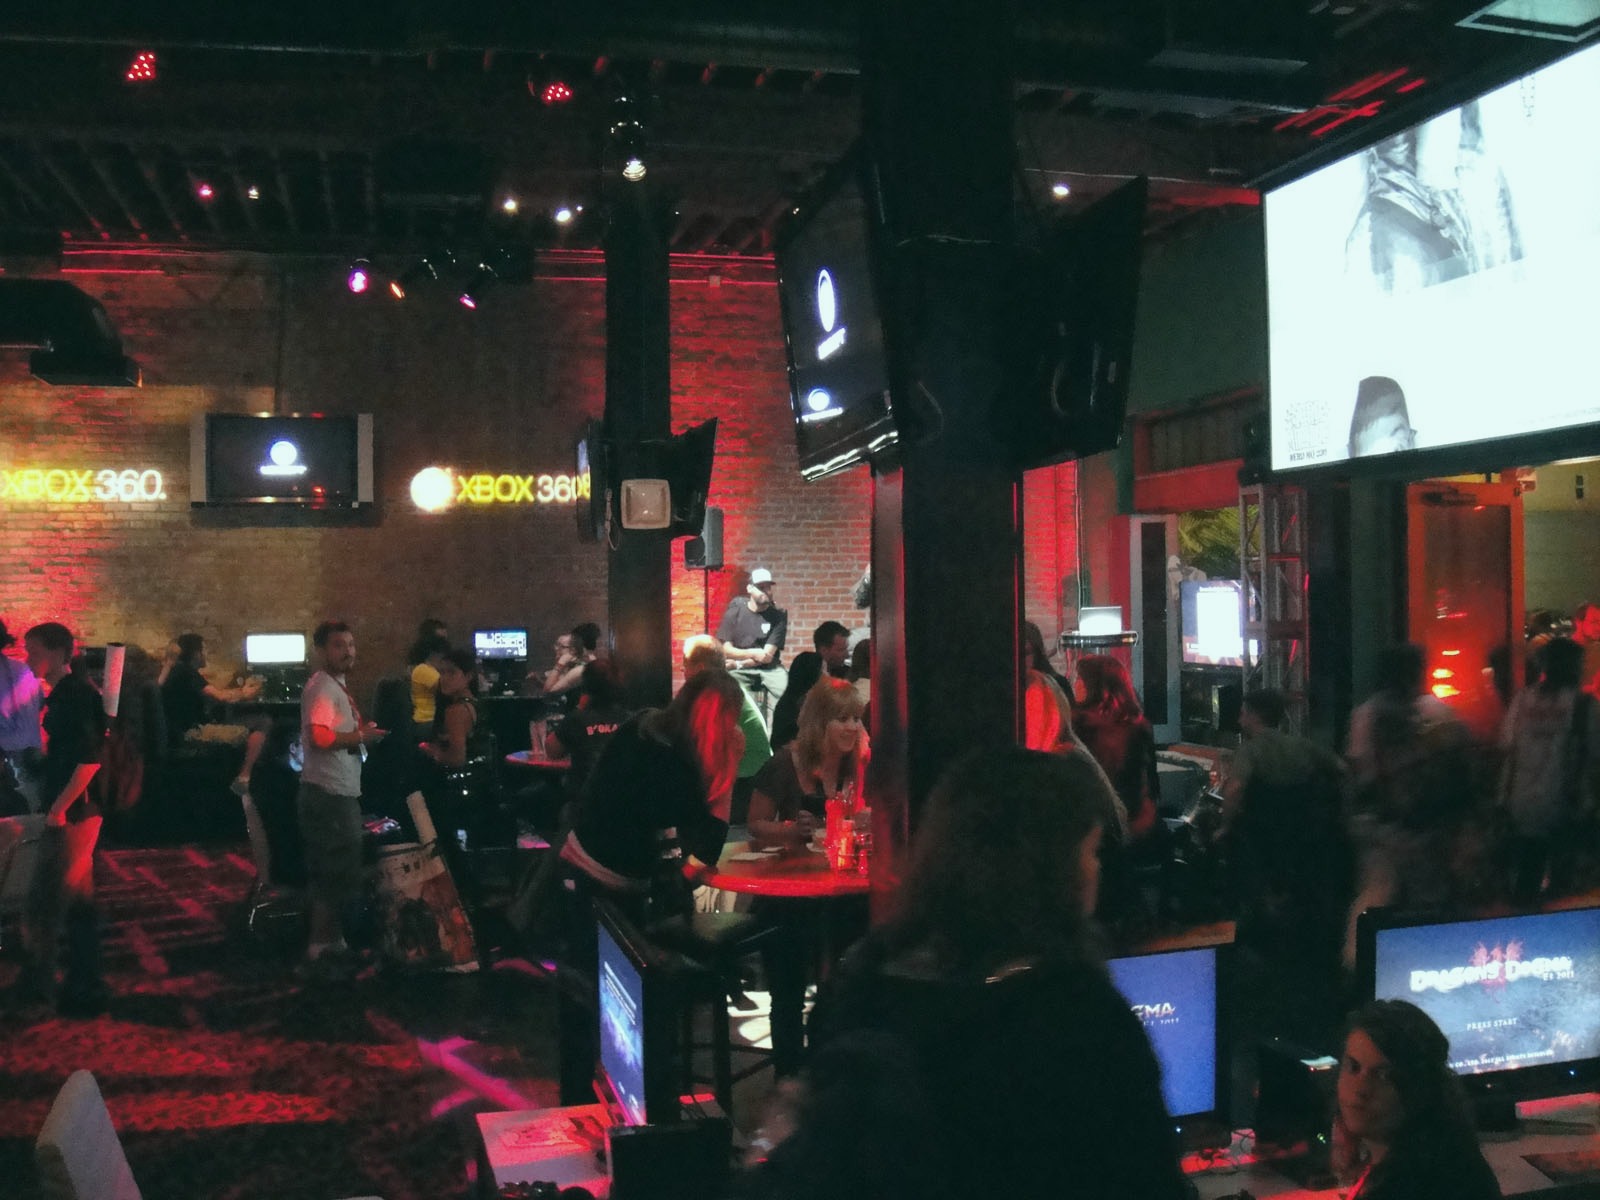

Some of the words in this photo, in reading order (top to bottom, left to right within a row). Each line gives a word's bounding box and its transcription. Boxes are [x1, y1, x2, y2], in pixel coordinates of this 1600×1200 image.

[0, 469, 93, 502] XBOX
[457, 474, 535, 503] XBOX
[1493, 1017, 1518, 1027] START
